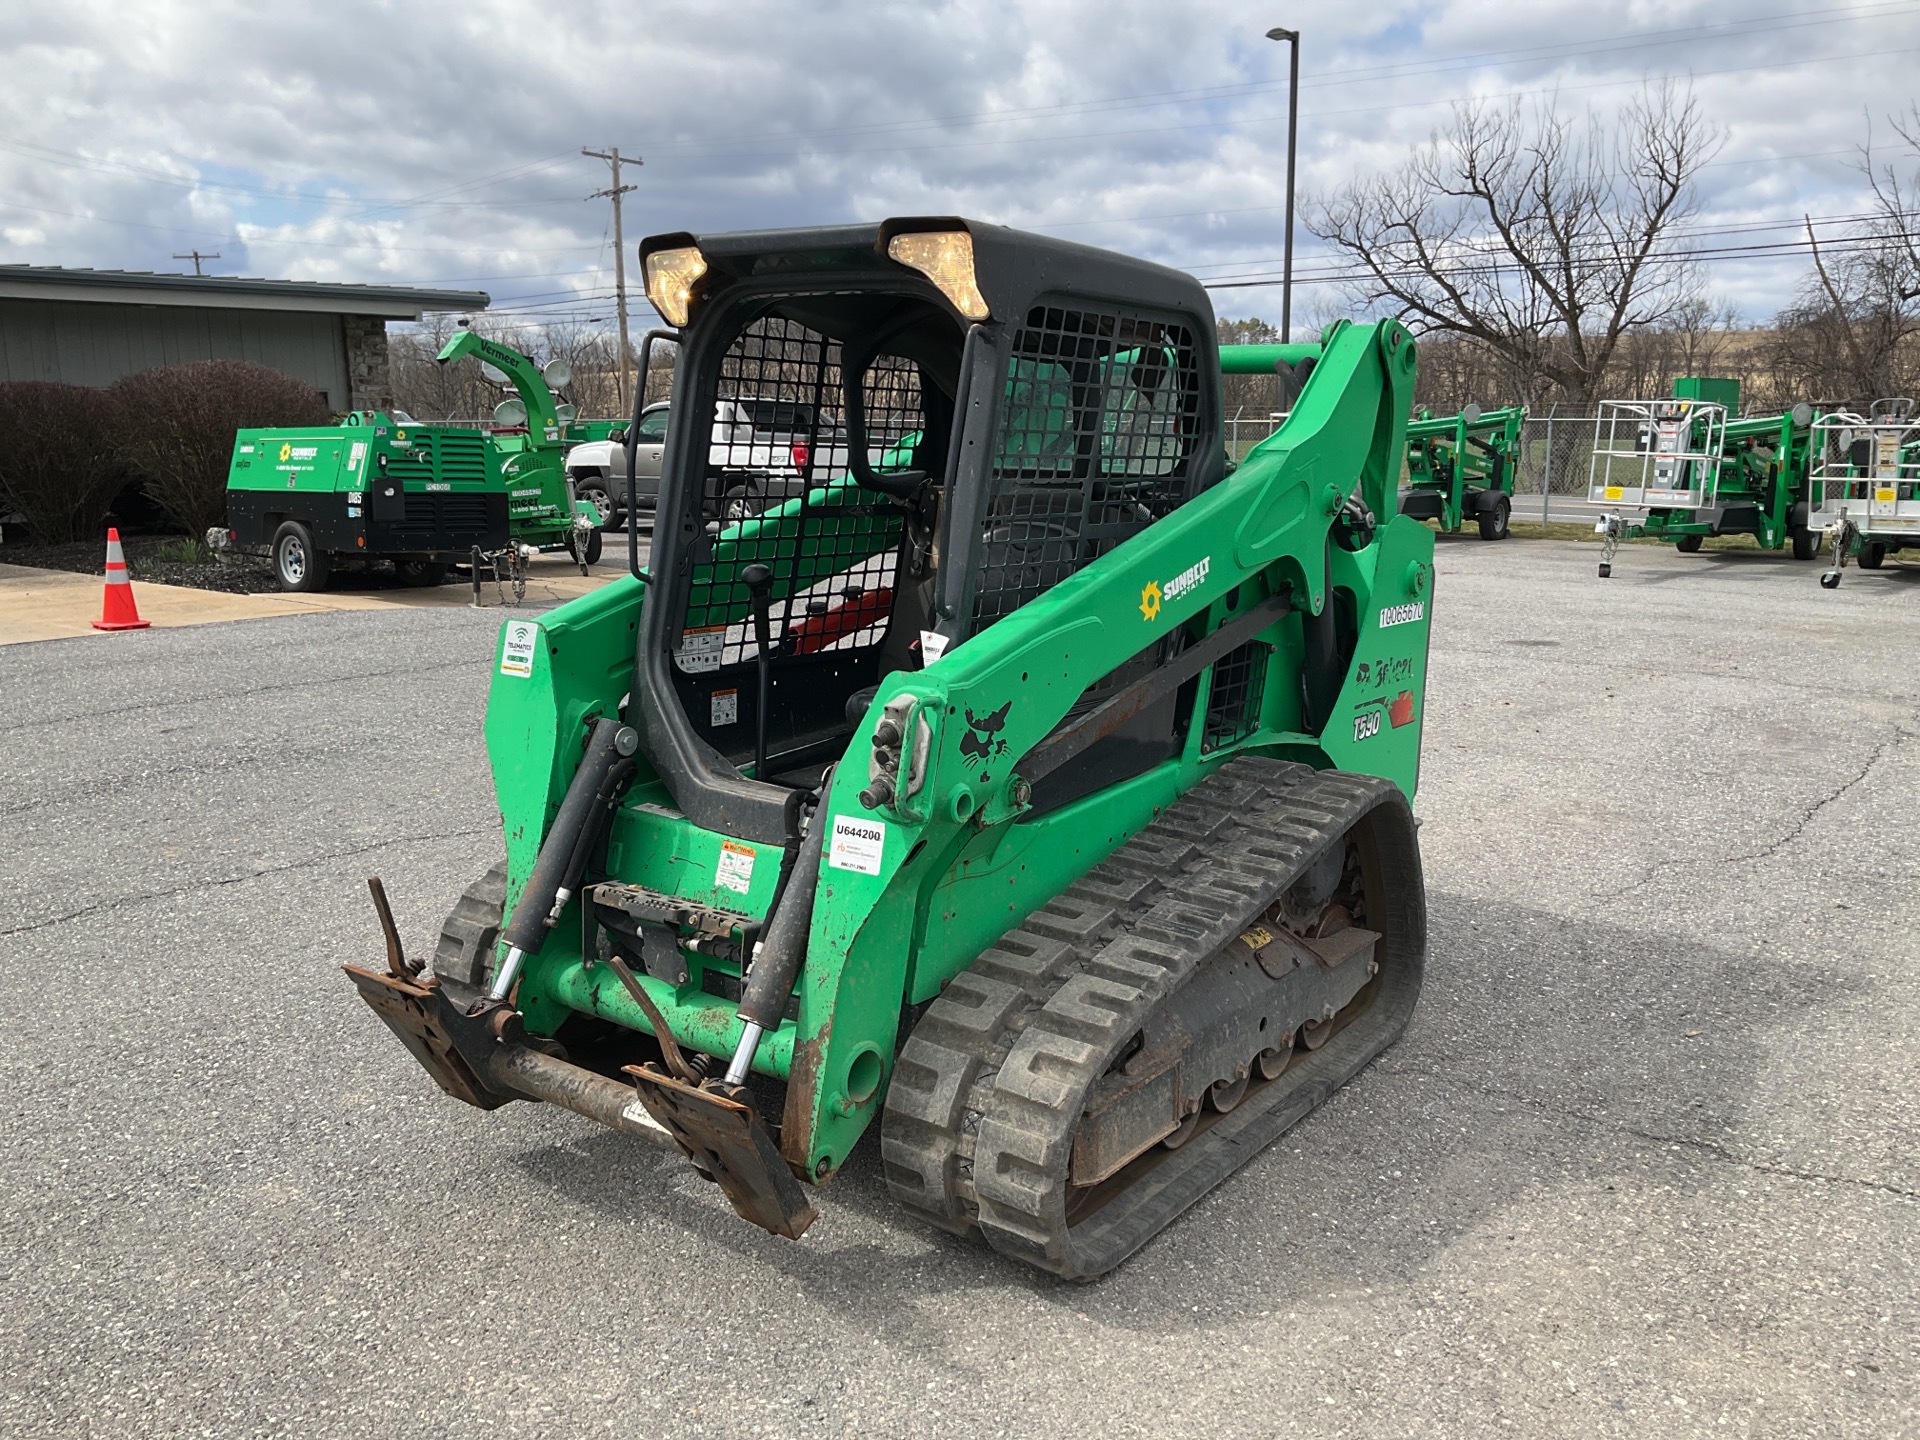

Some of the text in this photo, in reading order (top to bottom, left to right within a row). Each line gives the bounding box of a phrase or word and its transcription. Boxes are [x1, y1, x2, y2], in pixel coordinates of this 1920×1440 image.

[480, 340, 520, 368] Vermeer
[290, 447, 318, 458] SUNBELT
[510, 498, 539, 508] meer
[1163, 555, 1211, 602] SUNBELT
[1380, 601, 1424, 626] 10065670
[1353, 710, 1381, 743] T590
[836, 824, 881, 842] U644200
